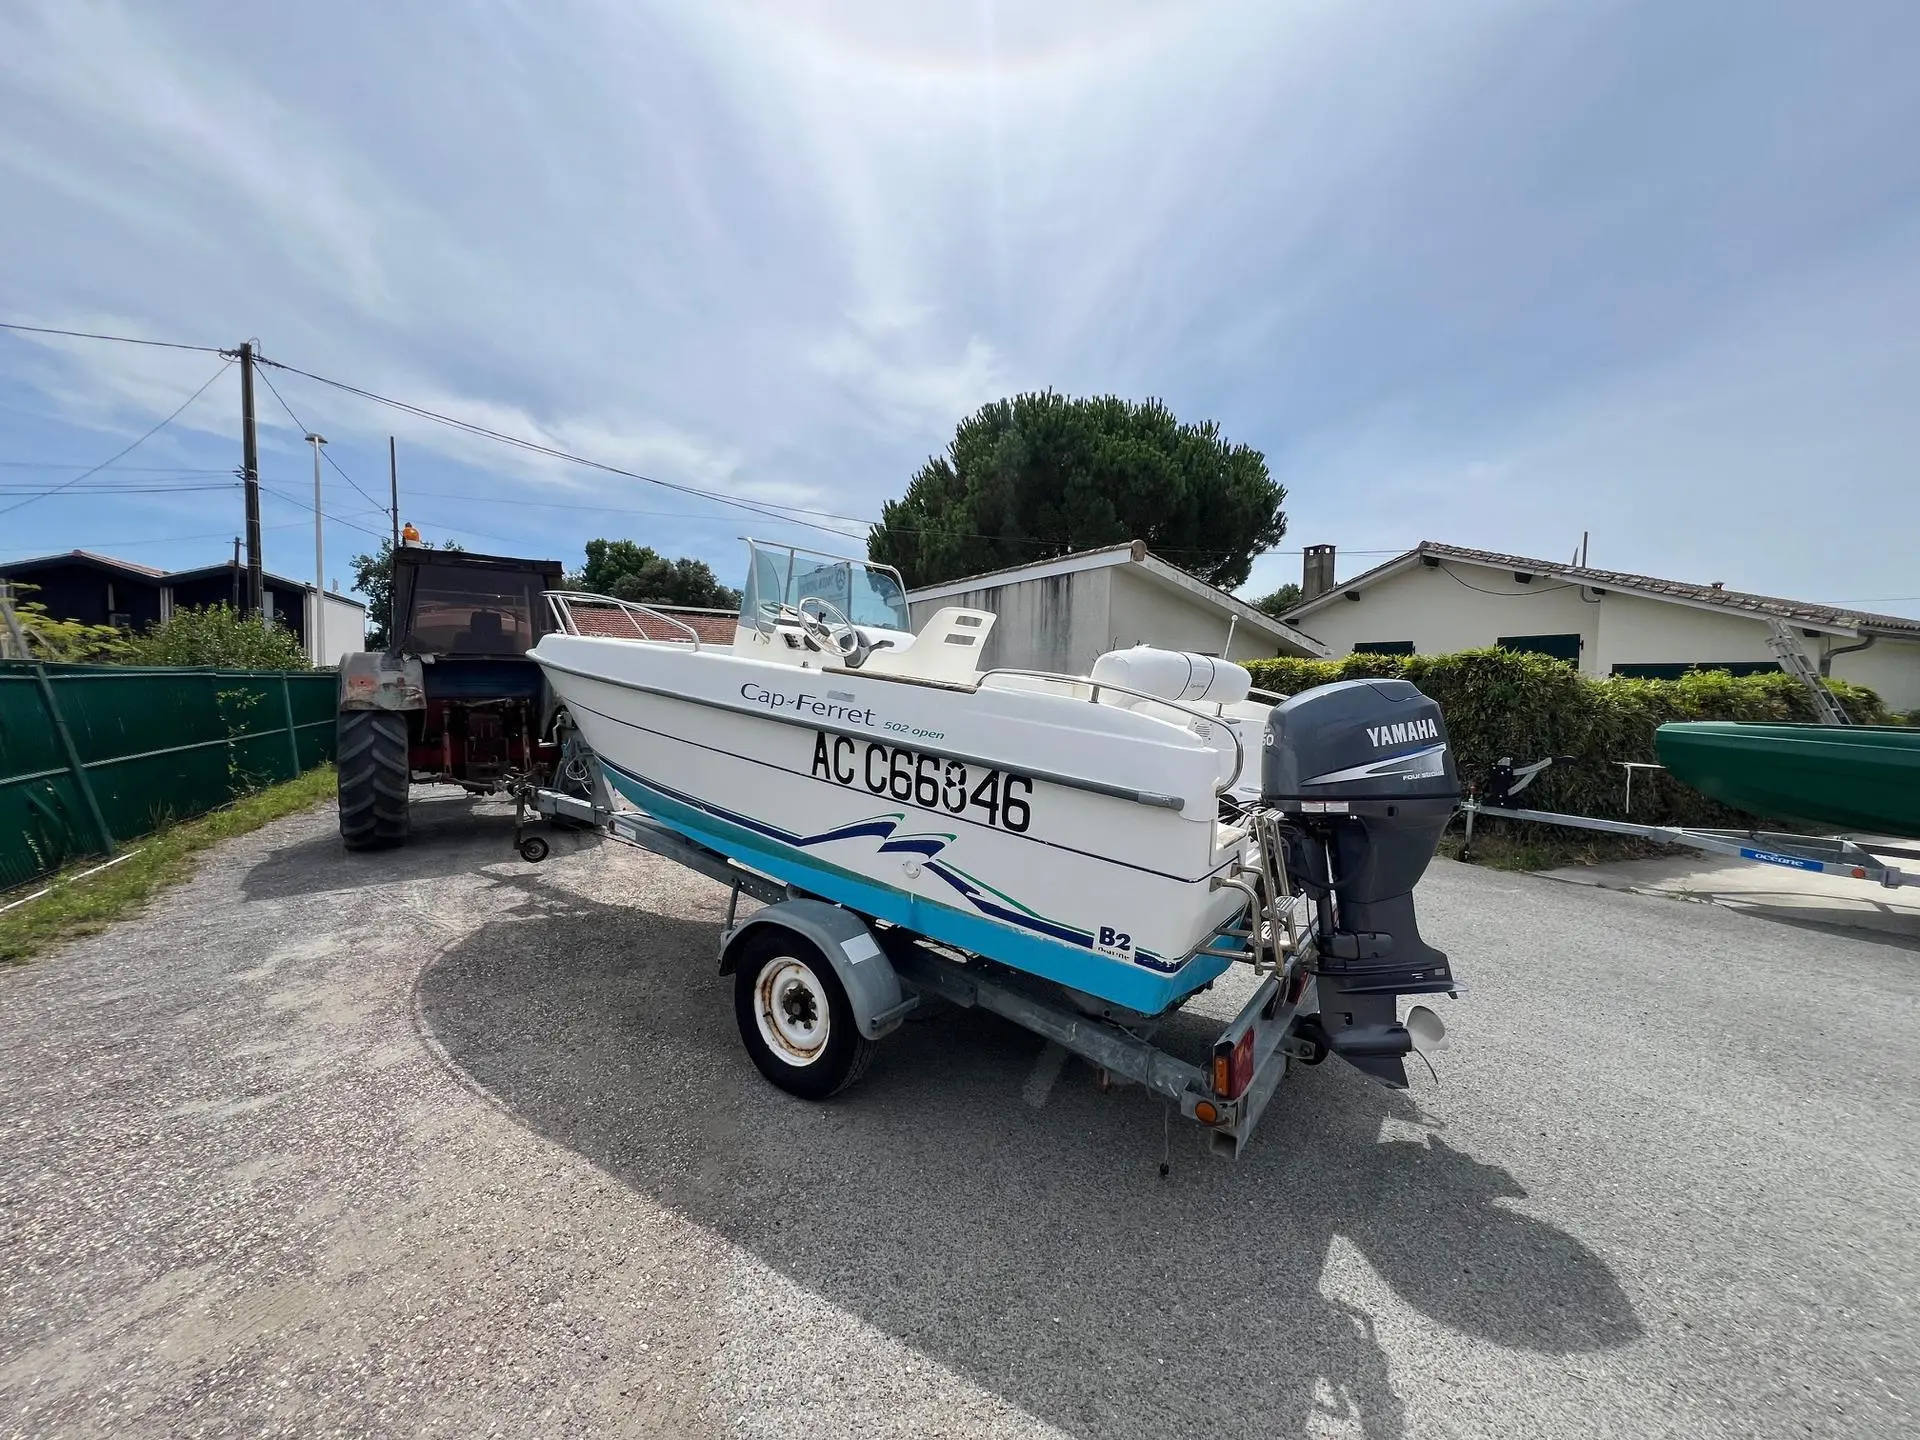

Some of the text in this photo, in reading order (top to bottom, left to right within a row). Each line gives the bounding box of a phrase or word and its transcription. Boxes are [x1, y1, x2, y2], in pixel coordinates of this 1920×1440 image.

[883, 721, 910, 734] 502
[911, 728, 945, 741] open
[1366, 718, 1439, 748] YAMAHA
[811, 731, 1034, 833] AC C66846
[1099, 926, 1131, 951] B2
